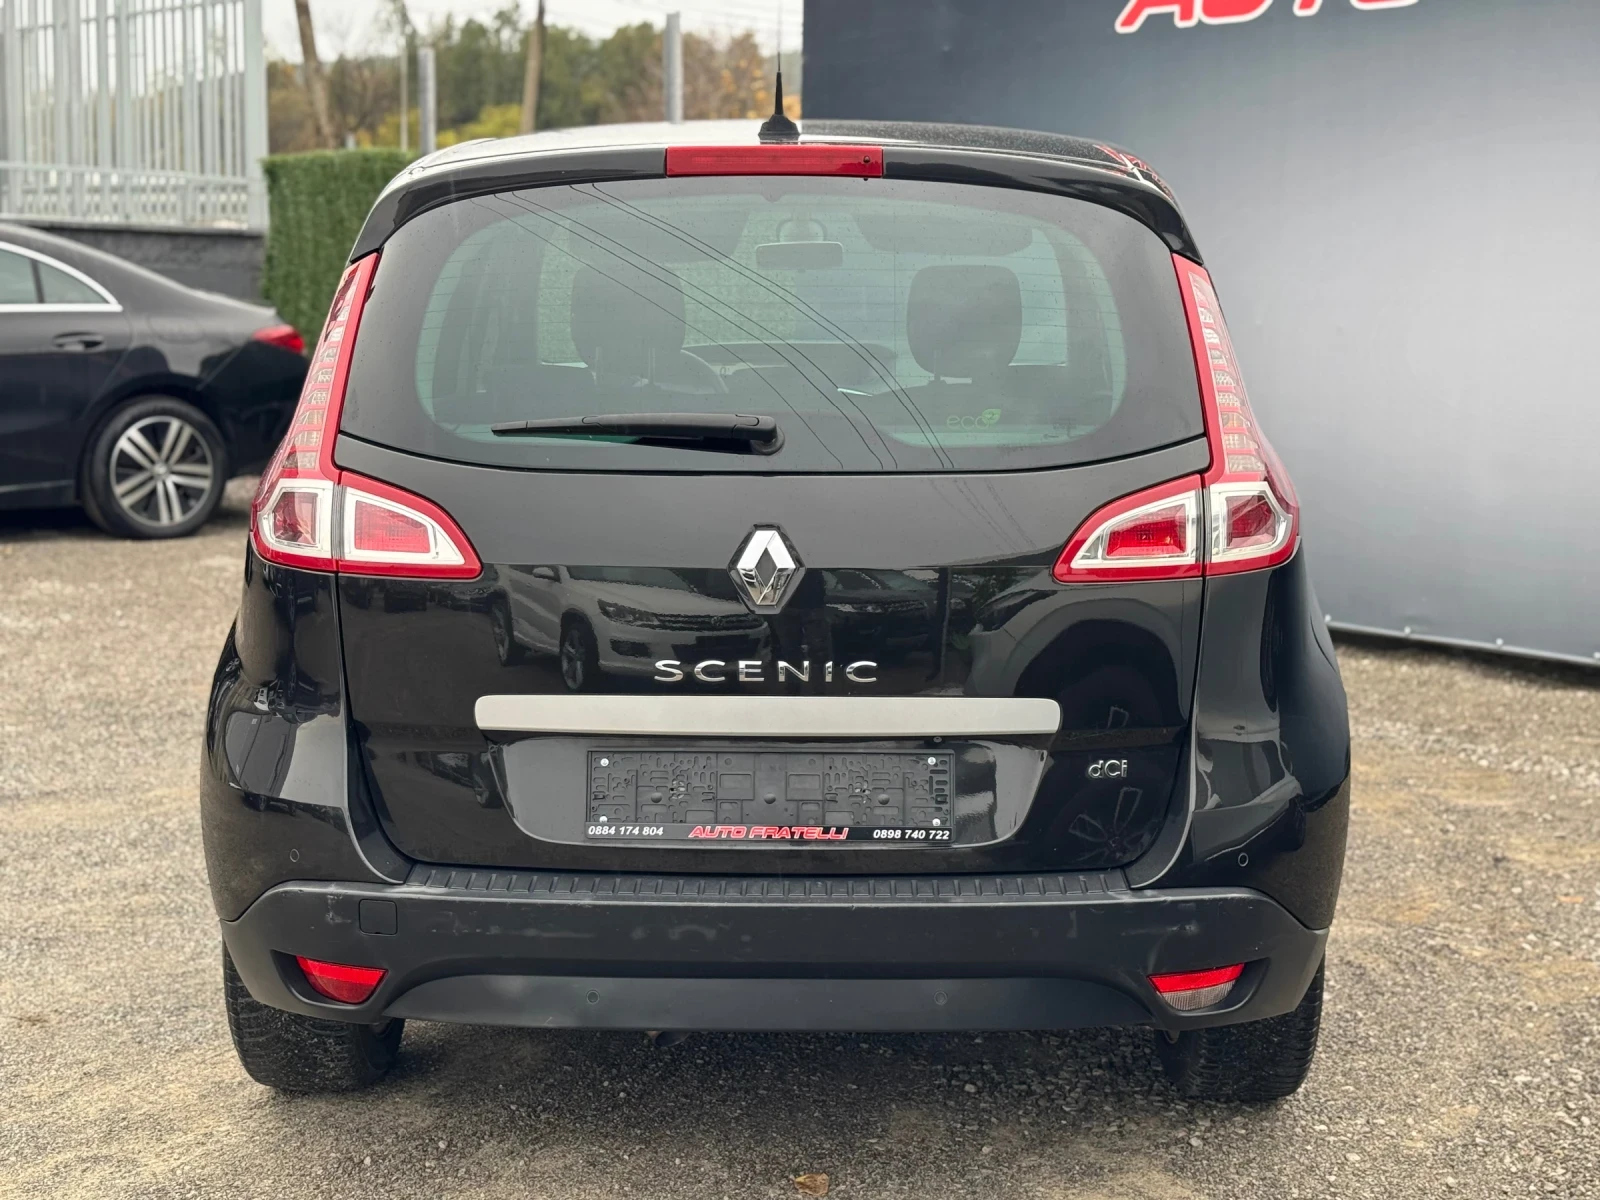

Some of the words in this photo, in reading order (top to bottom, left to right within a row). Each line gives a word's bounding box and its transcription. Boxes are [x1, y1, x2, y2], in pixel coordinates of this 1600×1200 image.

[653, 659, 878, 683] SCENIC
[587, 825, 616, 836] 0884
[619, 826, 641, 836] 174
[642, 826, 664, 837] 804
[688, 825, 747, 839] AUTO
[748, 826, 849, 840] FRATELLI
[873, 829, 901, 839] 0898
[904, 829, 926, 840] 740
[928, 830, 950, 840] 722
